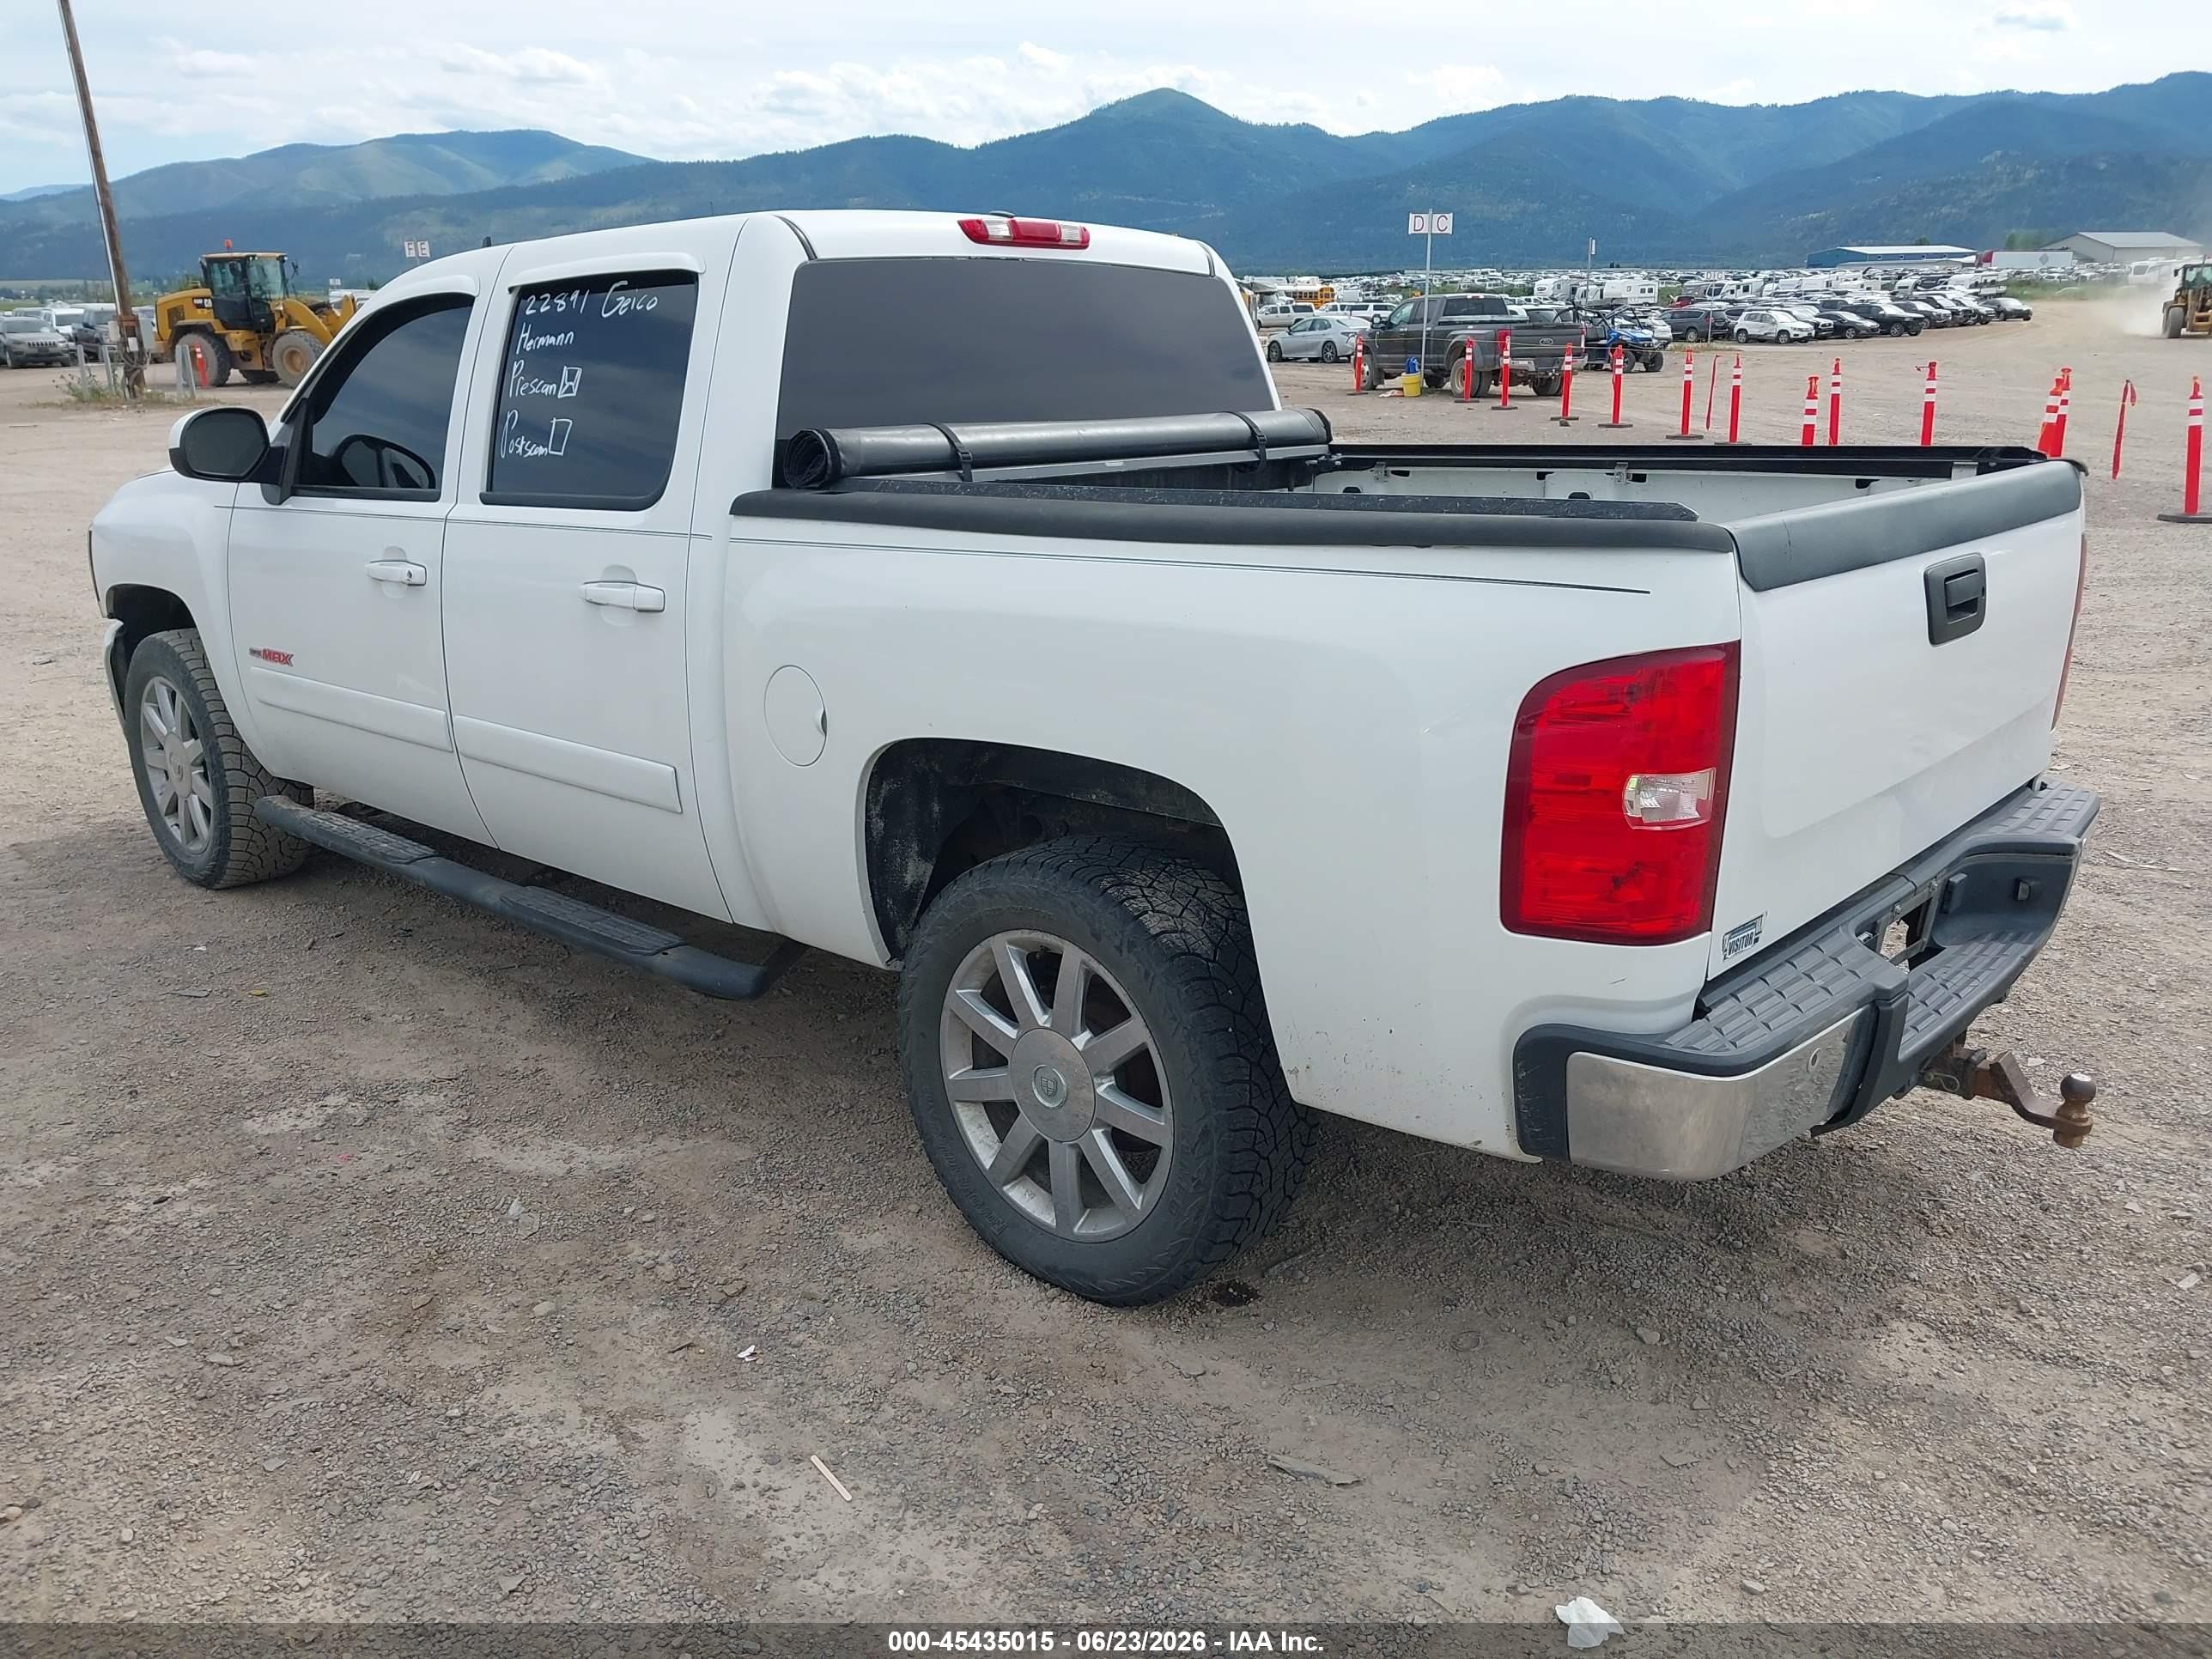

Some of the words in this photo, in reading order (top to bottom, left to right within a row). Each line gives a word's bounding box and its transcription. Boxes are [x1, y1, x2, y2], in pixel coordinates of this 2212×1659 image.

[1413, 215, 1425, 232] D
[1437, 215, 1448, 232] C
[420, 241, 427, 256] E
[525, 289, 590, 316] 22891
[601, 280, 659, 318] Geico
[516, 322, 574, 355] Hermann
[509, 360, 557, 399] Prescan
[1729, 932, 1753, 956] VISITOR
